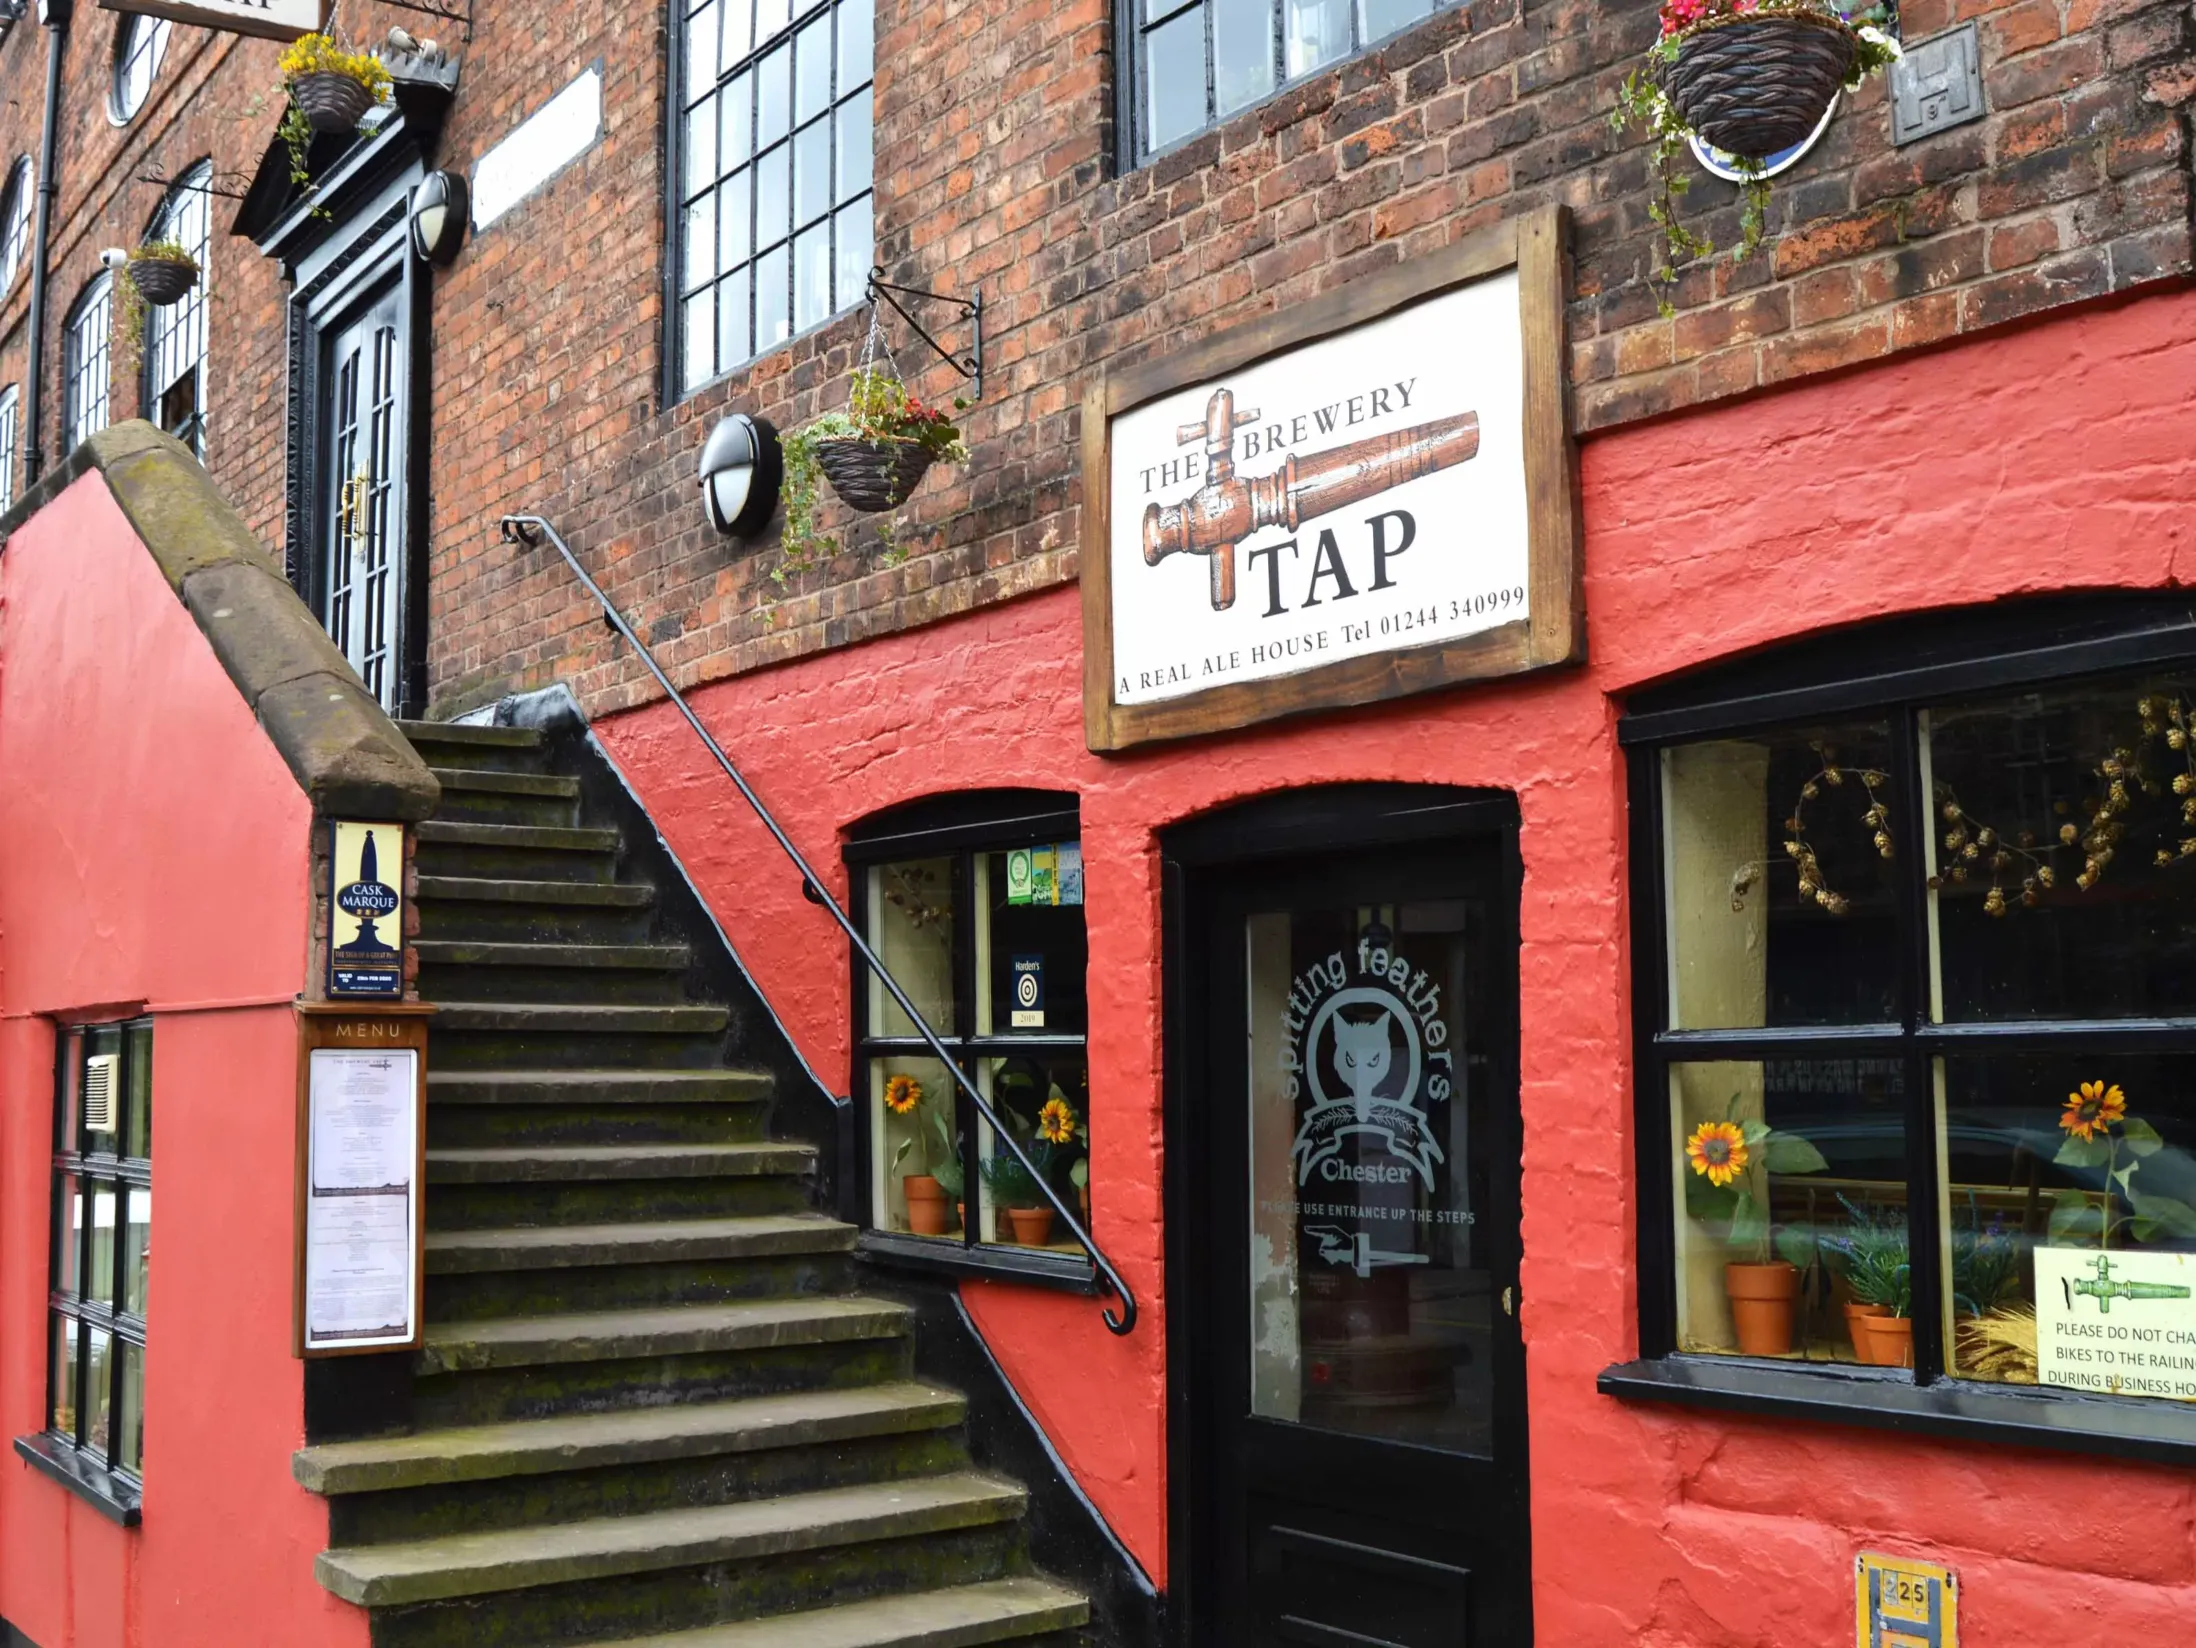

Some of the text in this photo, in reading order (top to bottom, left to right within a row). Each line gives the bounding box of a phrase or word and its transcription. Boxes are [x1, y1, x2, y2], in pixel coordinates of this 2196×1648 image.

[1139, 377, 1418, 495] THE BREWERY
[1247, 509, 1417, 619] TAP
[1119, 586, 1525, 695] A REAL ALE HOUSE Tel 01244 340999
[342, 895, 395, 909] MARQUE
[352, 884, 384, 897] CASK
[1015, 960, 1041, 972] Harden's
[1020, 1012, 1036, 1024] 2019
[1277, 936, 1453, 1102] spitting feathers
[335, 1022, 402, 1038] MENU
[1319, 1156, 1413, 1185] Chester
[1303, 1202, 1325, 1216] USE
[1328, 1204, 1388, 1220] ENTRANCE
[1391, 1207, 1407, 1220] UP
[1410, 1209, 1433, 1222] THE
[1436, 1210, 1476, 1225] STEPS
[2056, 1322, 2103, 1338] PLEASE
[2108, 1326, 2128, 1341] DO
[2132, 1328, 2162, 1342] NOT
[2056, 1346, 2196, 1371] BIKES TO THE RAILIN
[2048, 1370, 2101, 1388] DURING
[2105, 1374, 2171, 1394] BUSINESS
